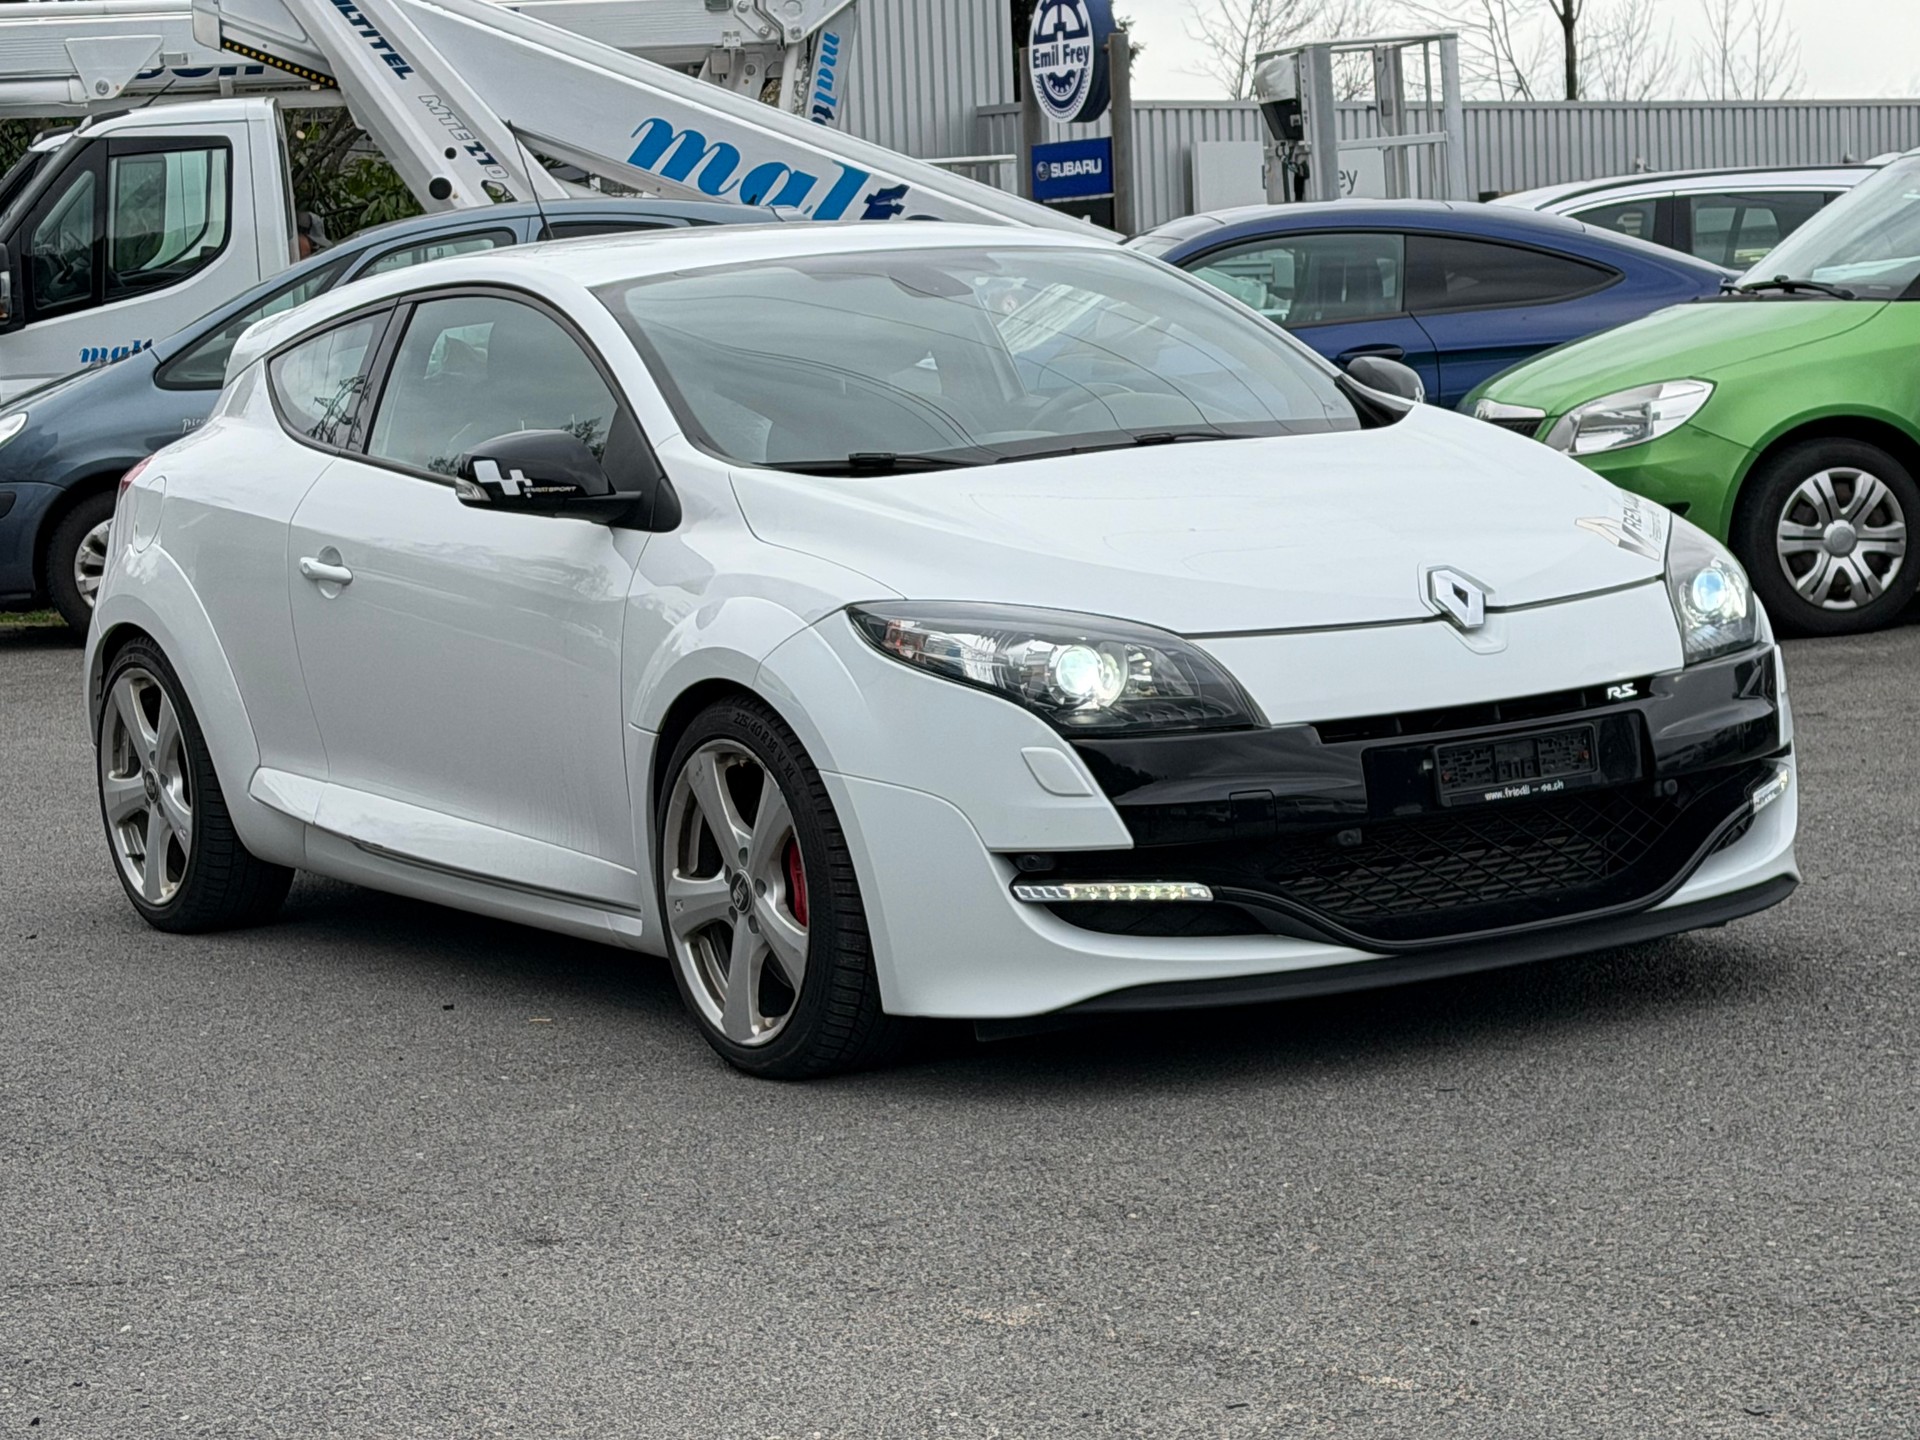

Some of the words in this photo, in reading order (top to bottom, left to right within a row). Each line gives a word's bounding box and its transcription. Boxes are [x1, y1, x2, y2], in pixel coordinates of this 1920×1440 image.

[1032, 44, 1060, 69] Emil
[1063, 43, 1090, 67] Frey
[627, 117, 945, 220] malt
[1050, 157, 1102, 178] SUBARU
